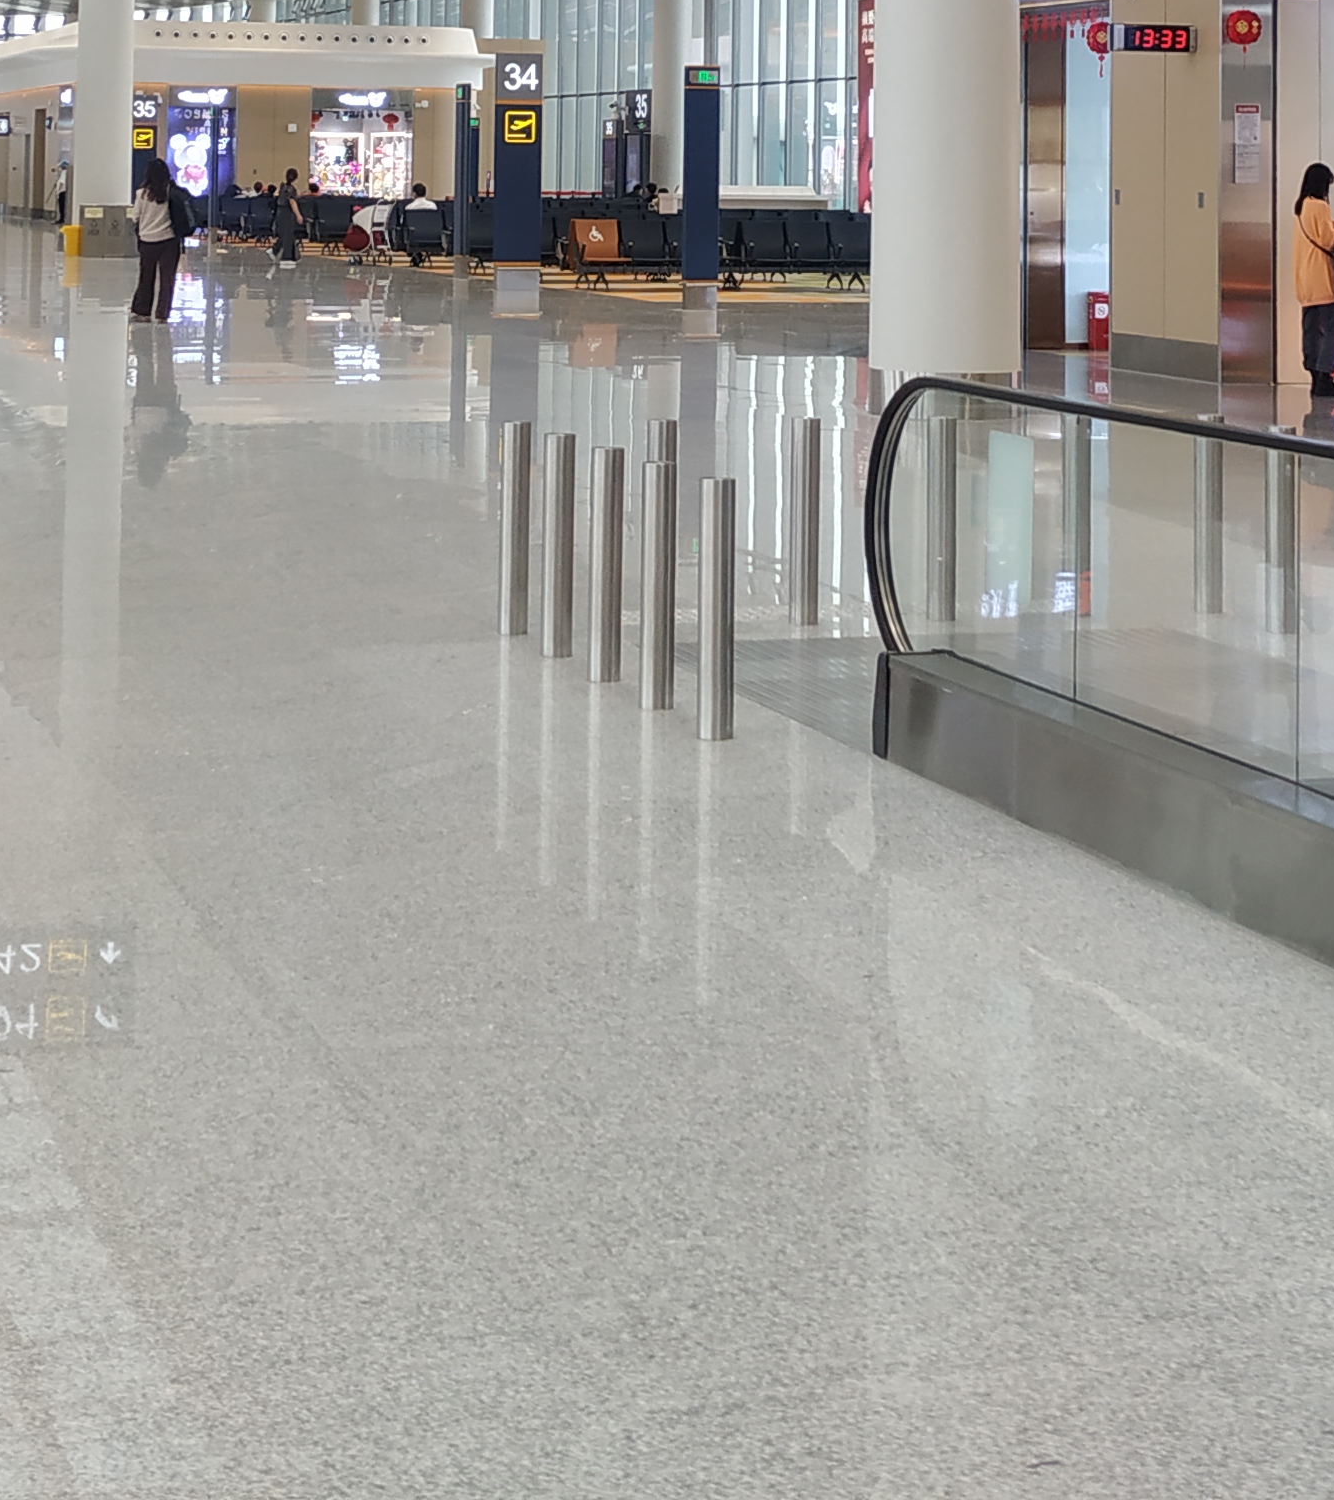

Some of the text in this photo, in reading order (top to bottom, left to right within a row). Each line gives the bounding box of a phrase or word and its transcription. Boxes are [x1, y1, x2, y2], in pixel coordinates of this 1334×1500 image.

[1134, 29, 1188, 49] 13:33
[503, 62, 539, 91] 34
[133, 101, 156, 118] 35
[635, 94, 648, 118] 35
